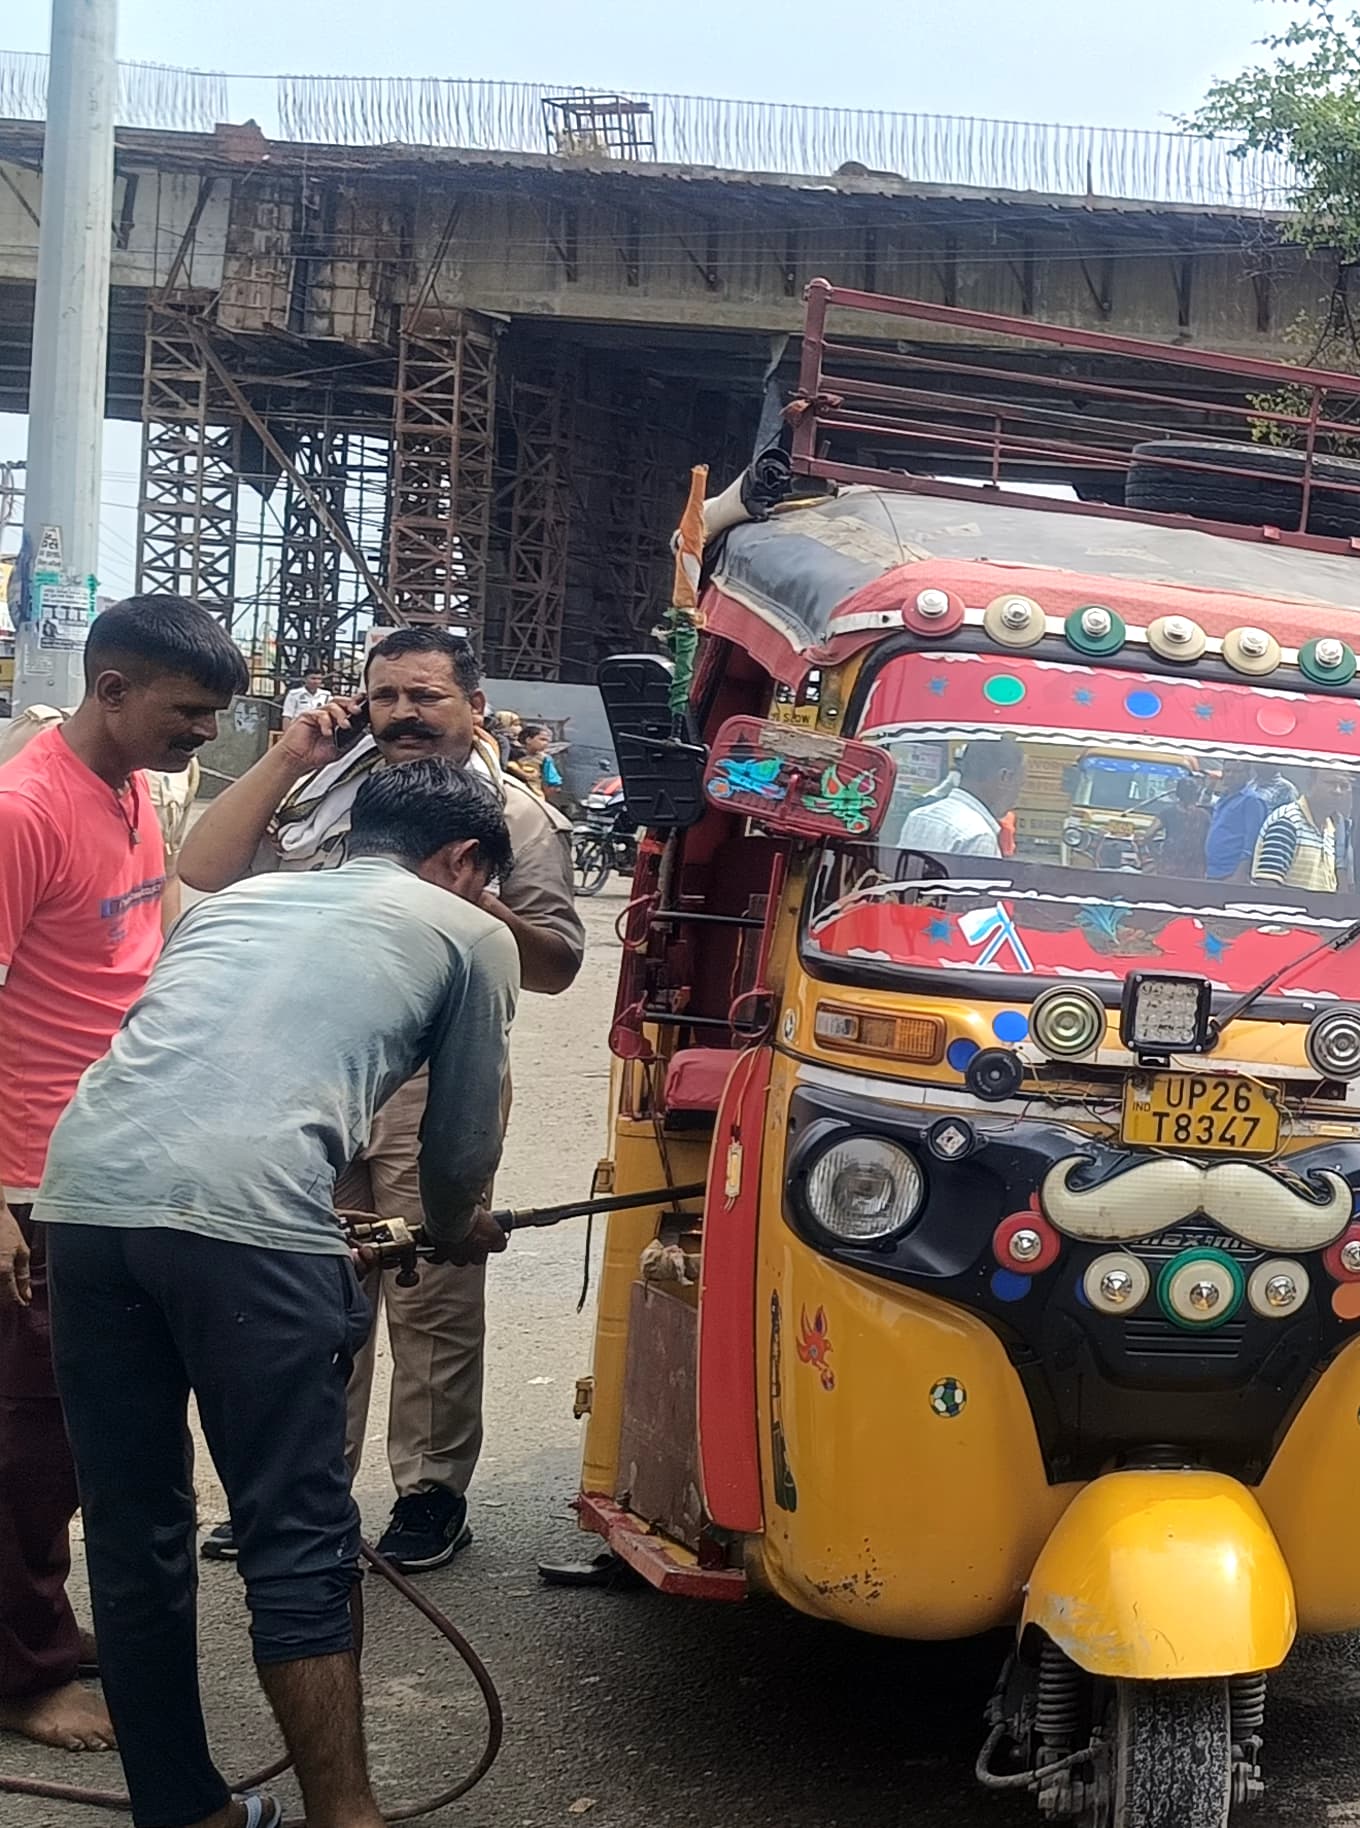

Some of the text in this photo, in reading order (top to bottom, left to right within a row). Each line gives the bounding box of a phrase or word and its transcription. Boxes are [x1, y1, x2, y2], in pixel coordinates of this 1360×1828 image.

[1132, 1102, 1151, 1112] IND
[1166, 1078, 1252, 1113] UP26
[1152, 1111, 1261, 1147] T8347
